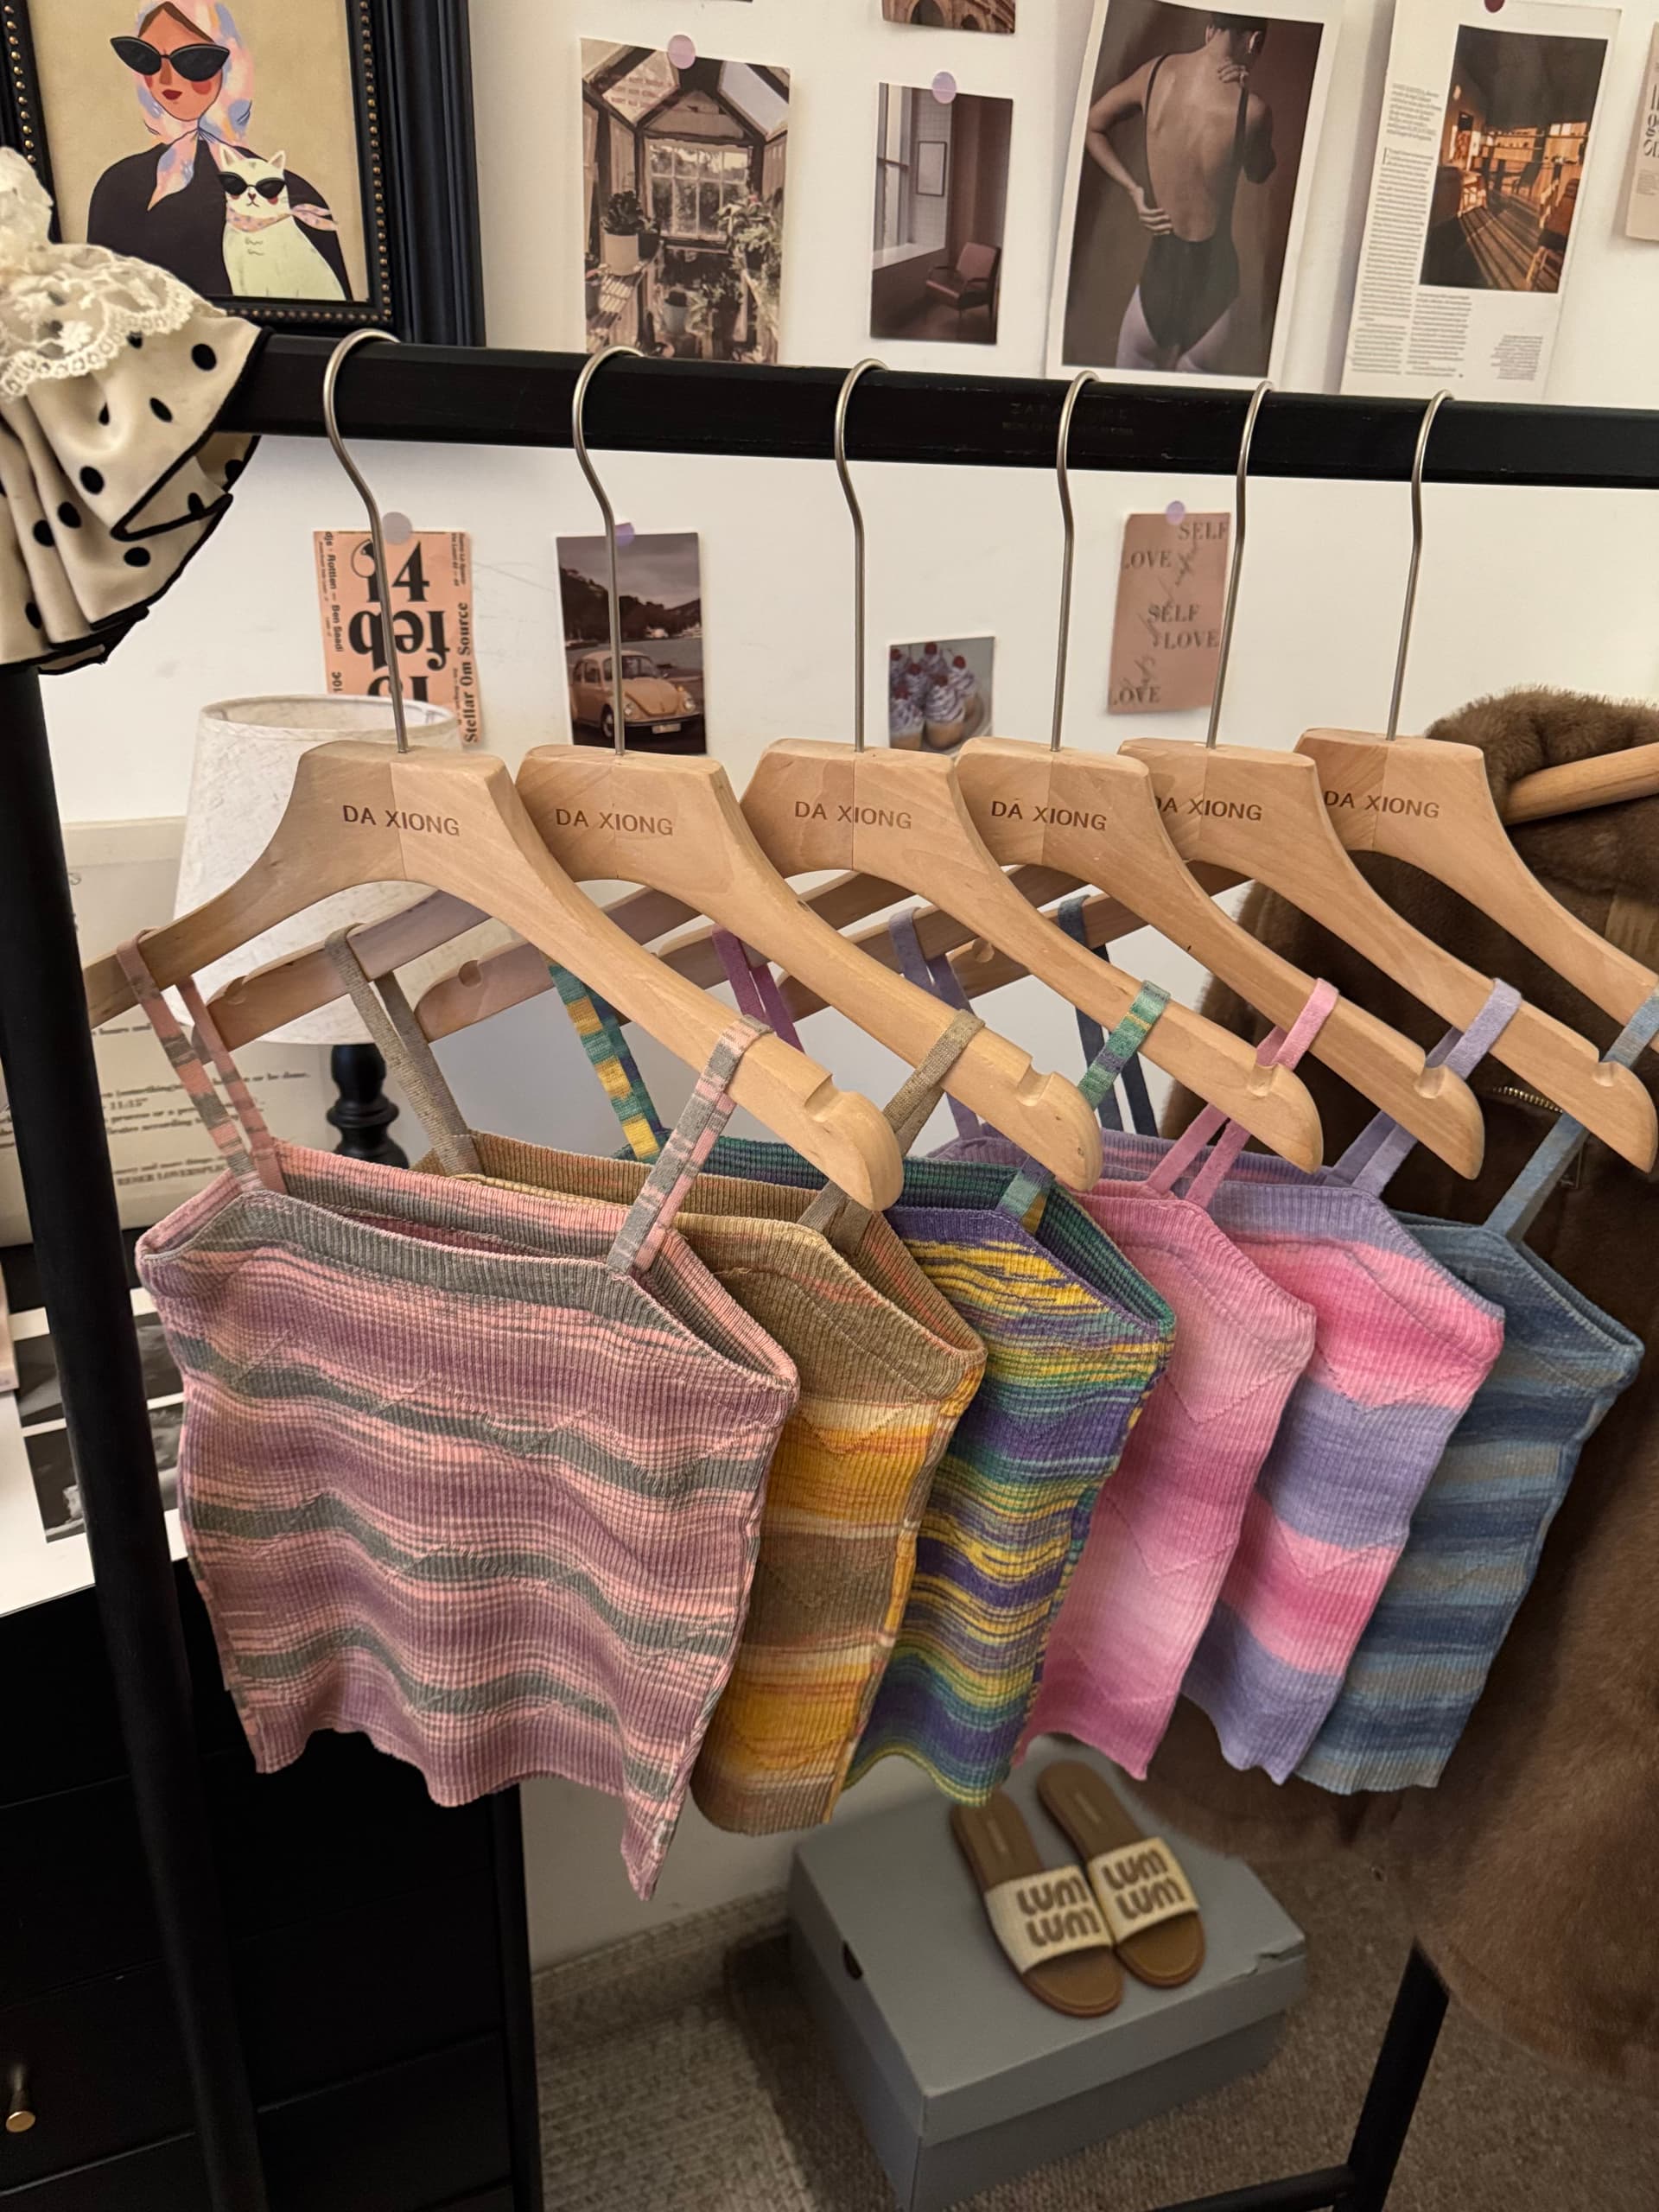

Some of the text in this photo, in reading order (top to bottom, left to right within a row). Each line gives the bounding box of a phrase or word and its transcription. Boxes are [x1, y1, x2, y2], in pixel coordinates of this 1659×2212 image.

[1178, 521, 1229, 541] SELF
[1124, 550, 1173, 569] OVE
[1147, 604, 1199, 623] SELF
[457, 602, 471, 656] Source
[1164, 631, 1219, 650] LOVE
[460, 660, 474, 687] Om
[1113, 686, 1161, 706] OVE
[461, 692, 477, 743] Stellar
[794, 801, 912, 830] DA XIONG
[991, 801, 1107, 831] DA XIONG
[1188, 798, 1262, 821] XIONG
[1324, 791, 1440, 819] DA XIONG
[342, 804, 461, 836] DA XIONG
[556, 809, 673, 836] DA XIONG
